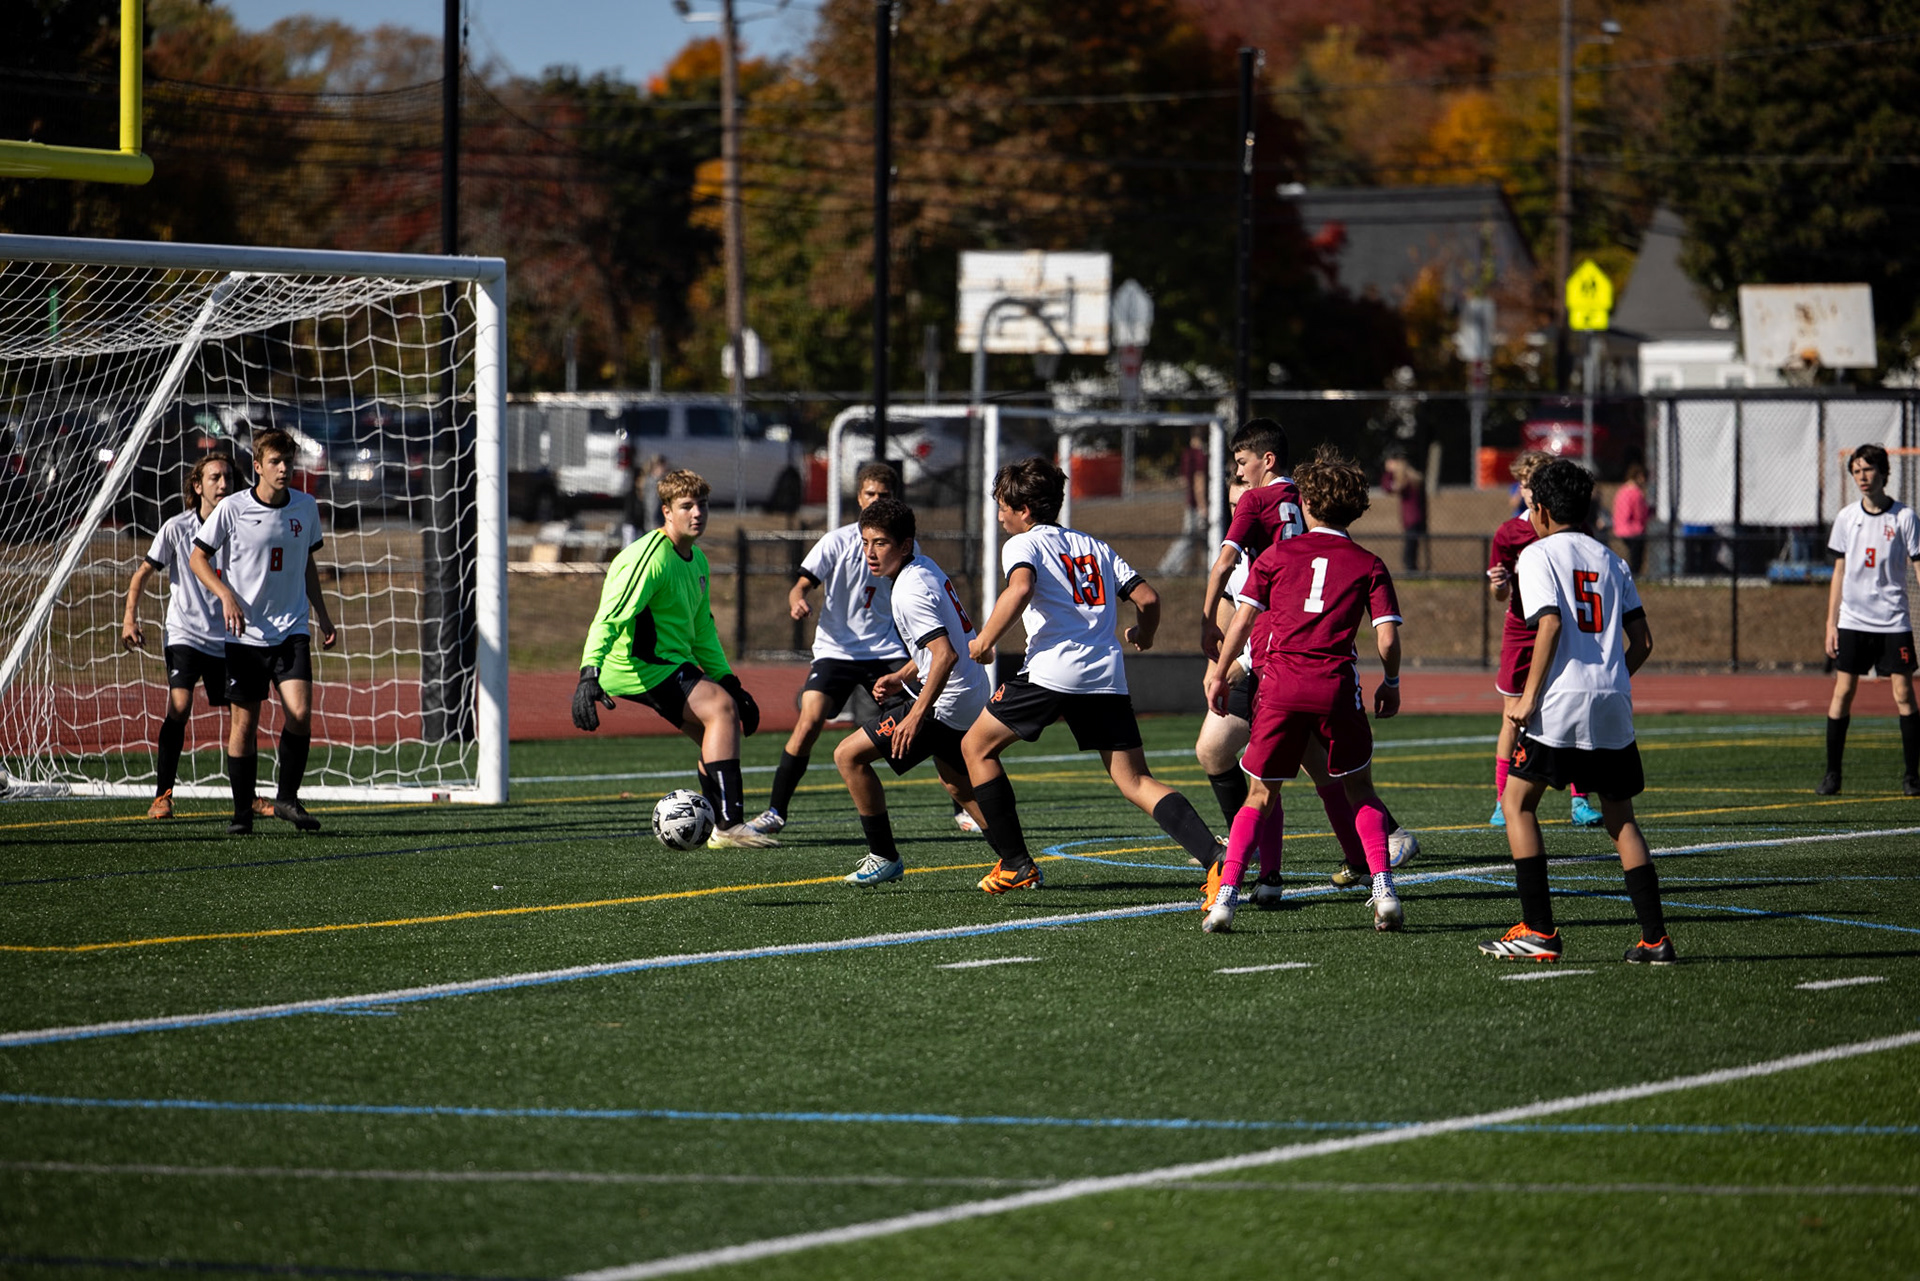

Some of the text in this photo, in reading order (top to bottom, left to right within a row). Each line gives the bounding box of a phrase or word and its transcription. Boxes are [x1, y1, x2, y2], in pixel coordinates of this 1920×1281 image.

[1278, 502, 1302, 540] 2
[271, 547, 283, 571] 8
[1865, 547, 1876, 568] 3
[864, 586, 877, 609] 7
[1059, 553, 1106, 606] 13
[1304, 556, 1328, 613] 1
[1573, 569, 1604, 633] 5
